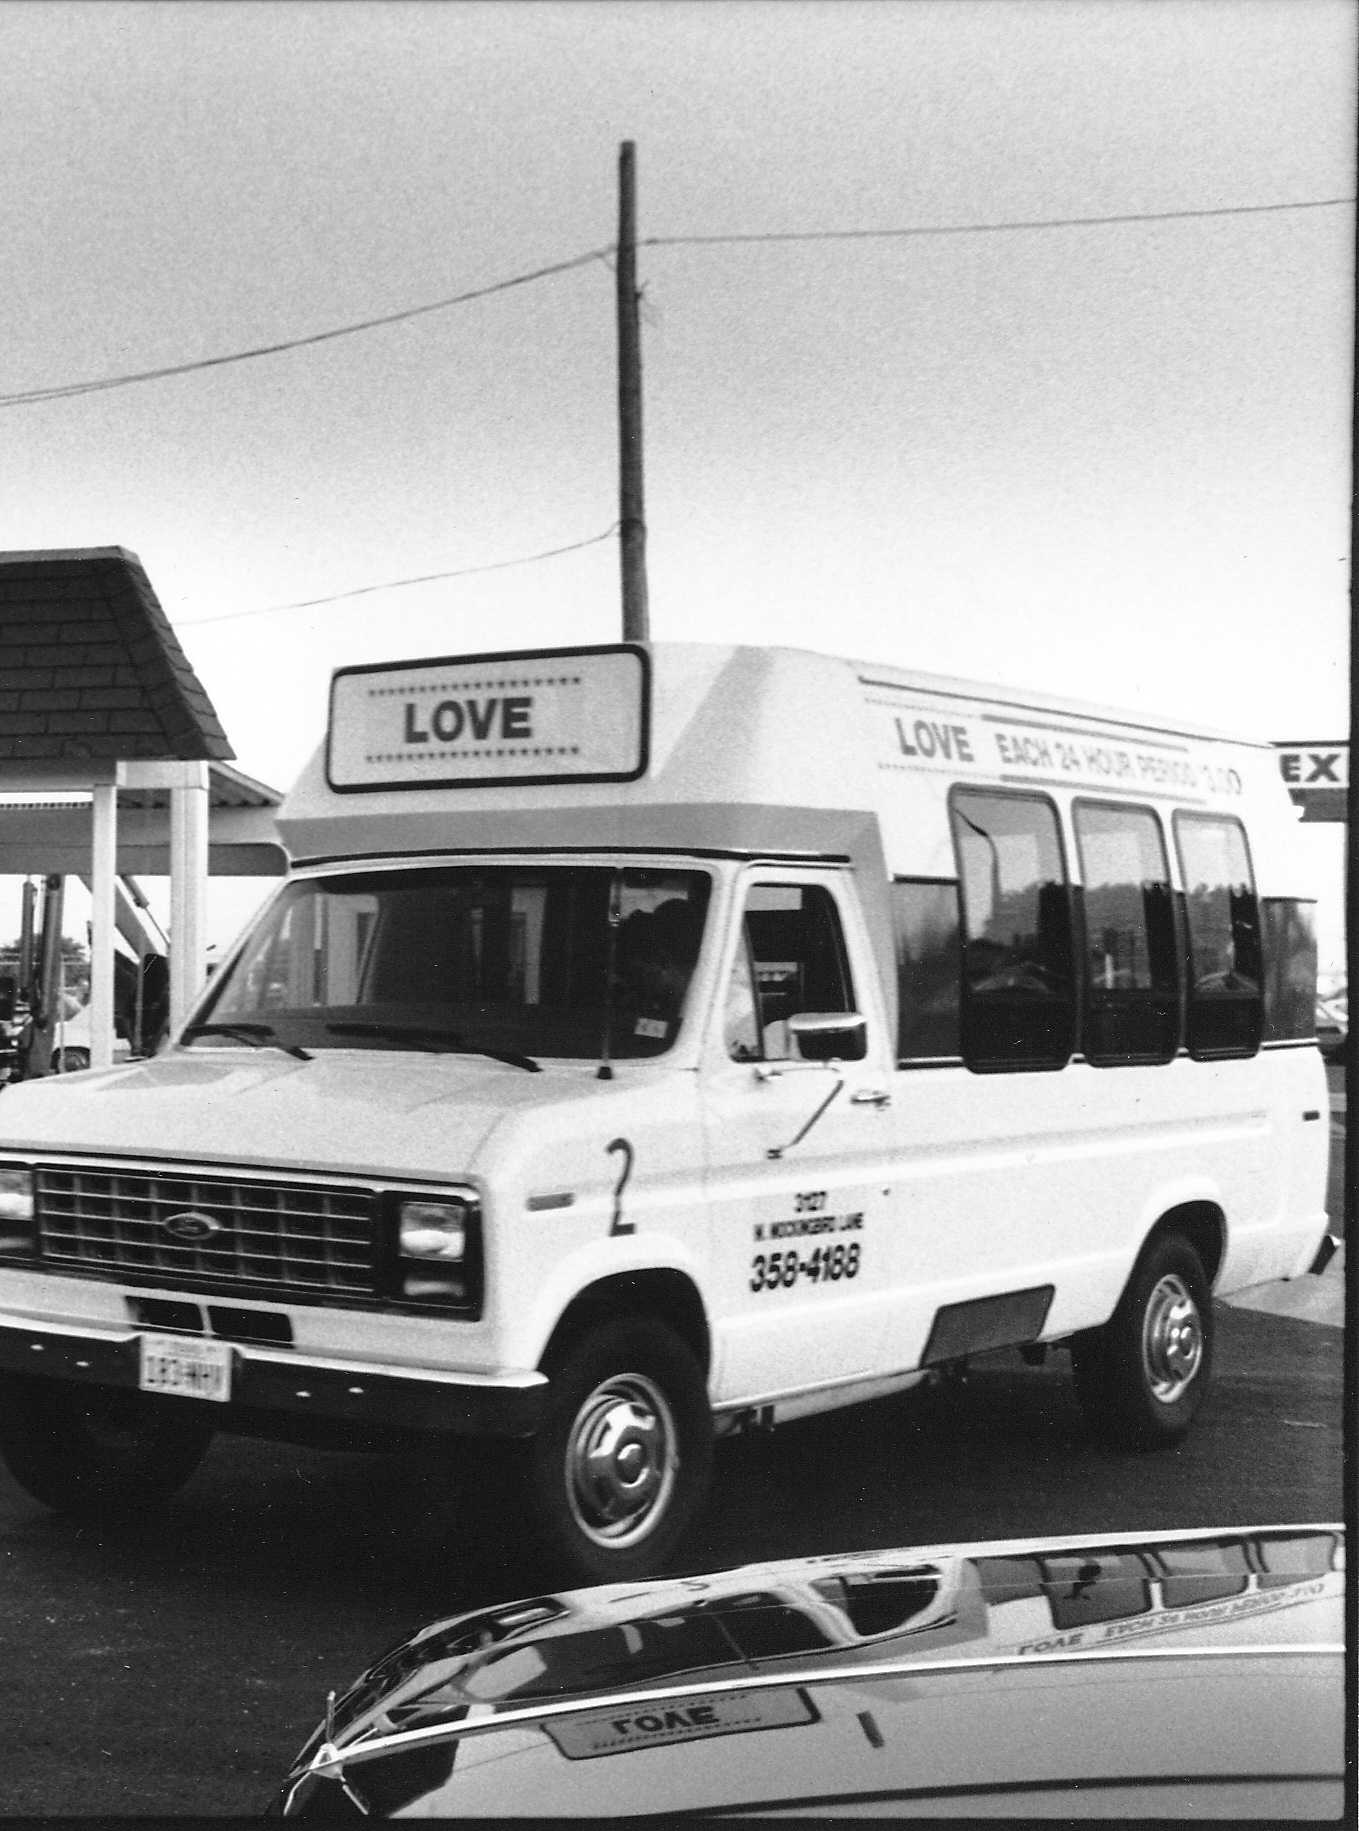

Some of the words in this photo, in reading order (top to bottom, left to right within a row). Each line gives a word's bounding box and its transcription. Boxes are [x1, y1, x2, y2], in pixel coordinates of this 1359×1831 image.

[404, 696, 533, 744] LOVE
[893, 716, 975, 763] LOVE
[993, 732, 1054, 768] EACH
[1054, 741, 1081, 771] 24
[606, 1137, 636, 1237] 2
[749, 1242, 861, 1293] 358-4188
